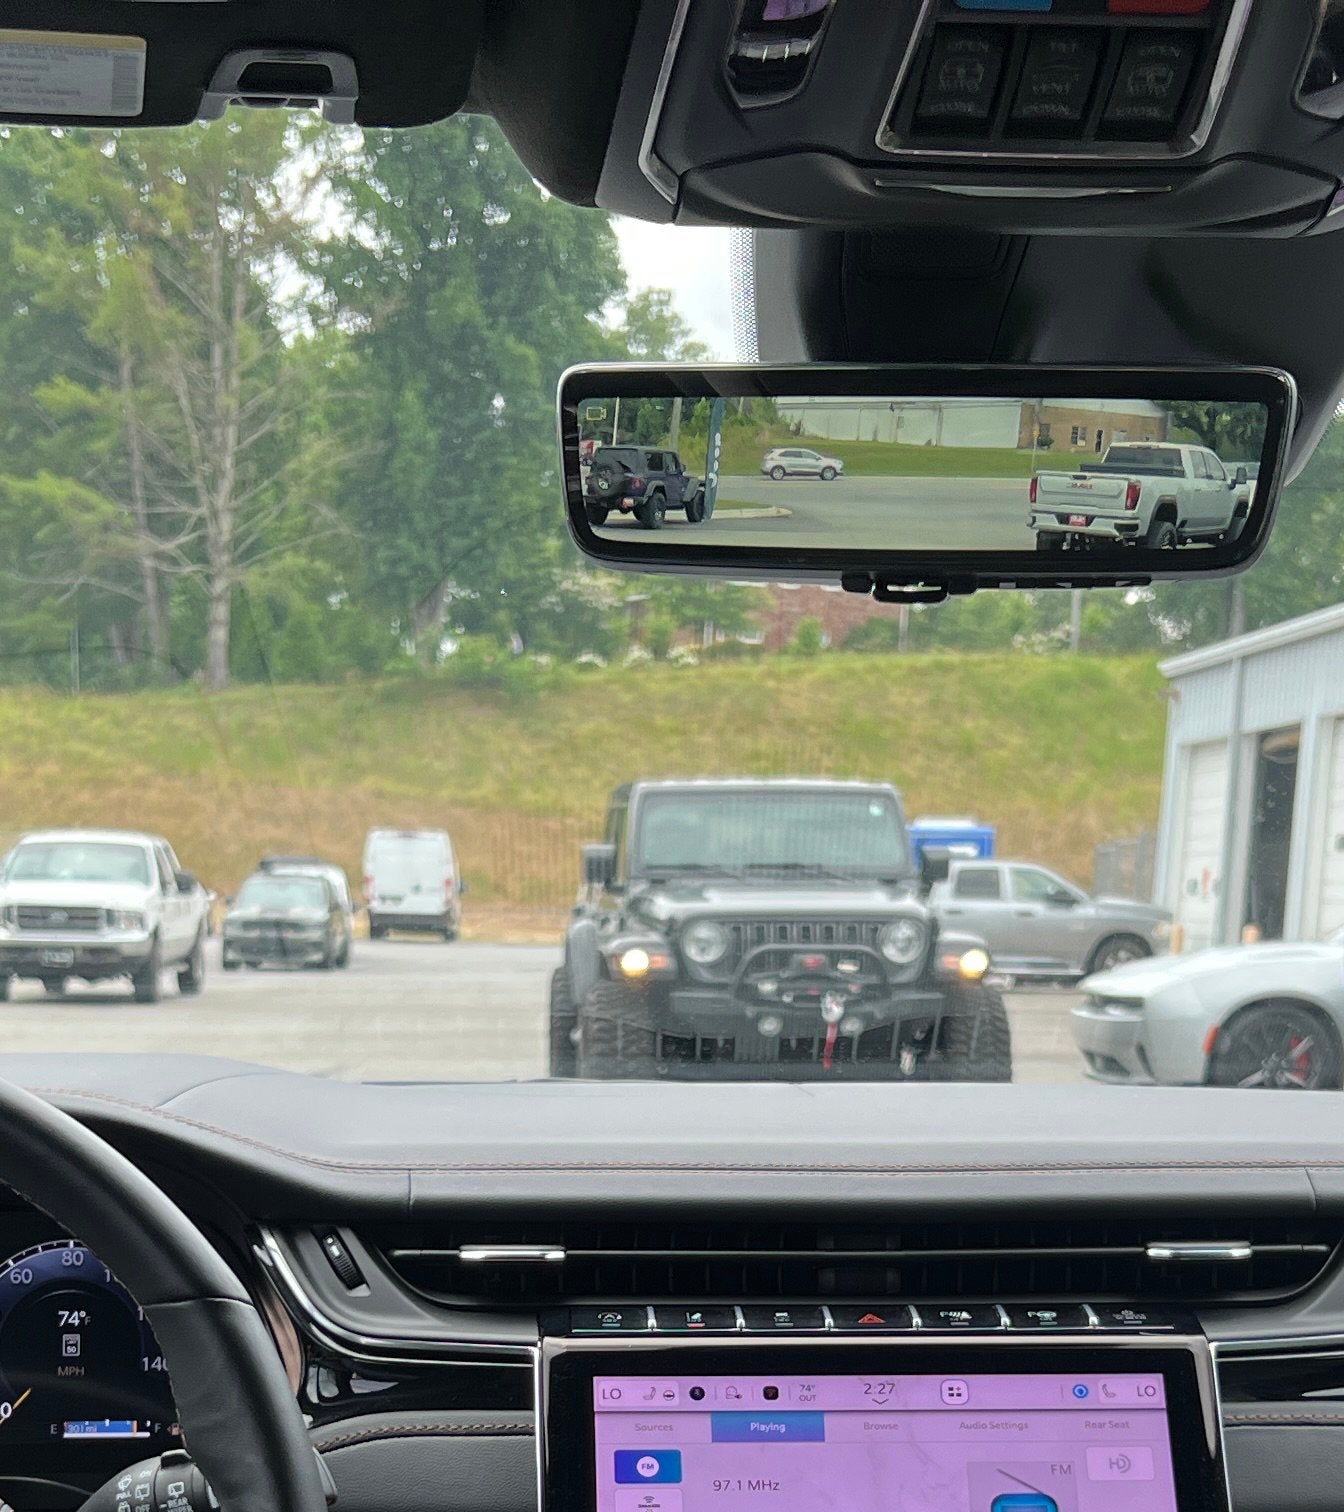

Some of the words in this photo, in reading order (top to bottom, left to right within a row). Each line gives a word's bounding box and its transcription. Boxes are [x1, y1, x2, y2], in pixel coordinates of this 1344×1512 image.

[61, 1250, 84, 1267] 80
[10, 1268, 33, 1285] 60
[57, 1366, 85, 1377] MPH
[602, 1388, 622, 1400] LO
[863, 1383, 896, 1395] 2:27
[1136, 1385, 1156, 1397] LO
[799, 1394, 817, 1402] OUT
[0, 1402, 13, 1418] 0
[50, 1424, 58, 1435] E
[155, 1423, 161, 1434] F
[634, 1422, 674, 1433] Sources
[750, 1421, 786, 1434] Playing
[863, 1421, 899, 1431] Browse
[959, 1420, 987, 1431] Audio
[989, 1421, 1029, 1432] Settings
[1084, 1420, 1106, 1430] Rear
[1108, 1419, 1130, 1430] Seat
[1050, 1464, 1072, 1475] FM
[712, 1479, 743, 1491] 97.1
[747, 1479, 780, 1491] MHz
[167, 1497, 188, 1509] REAR
